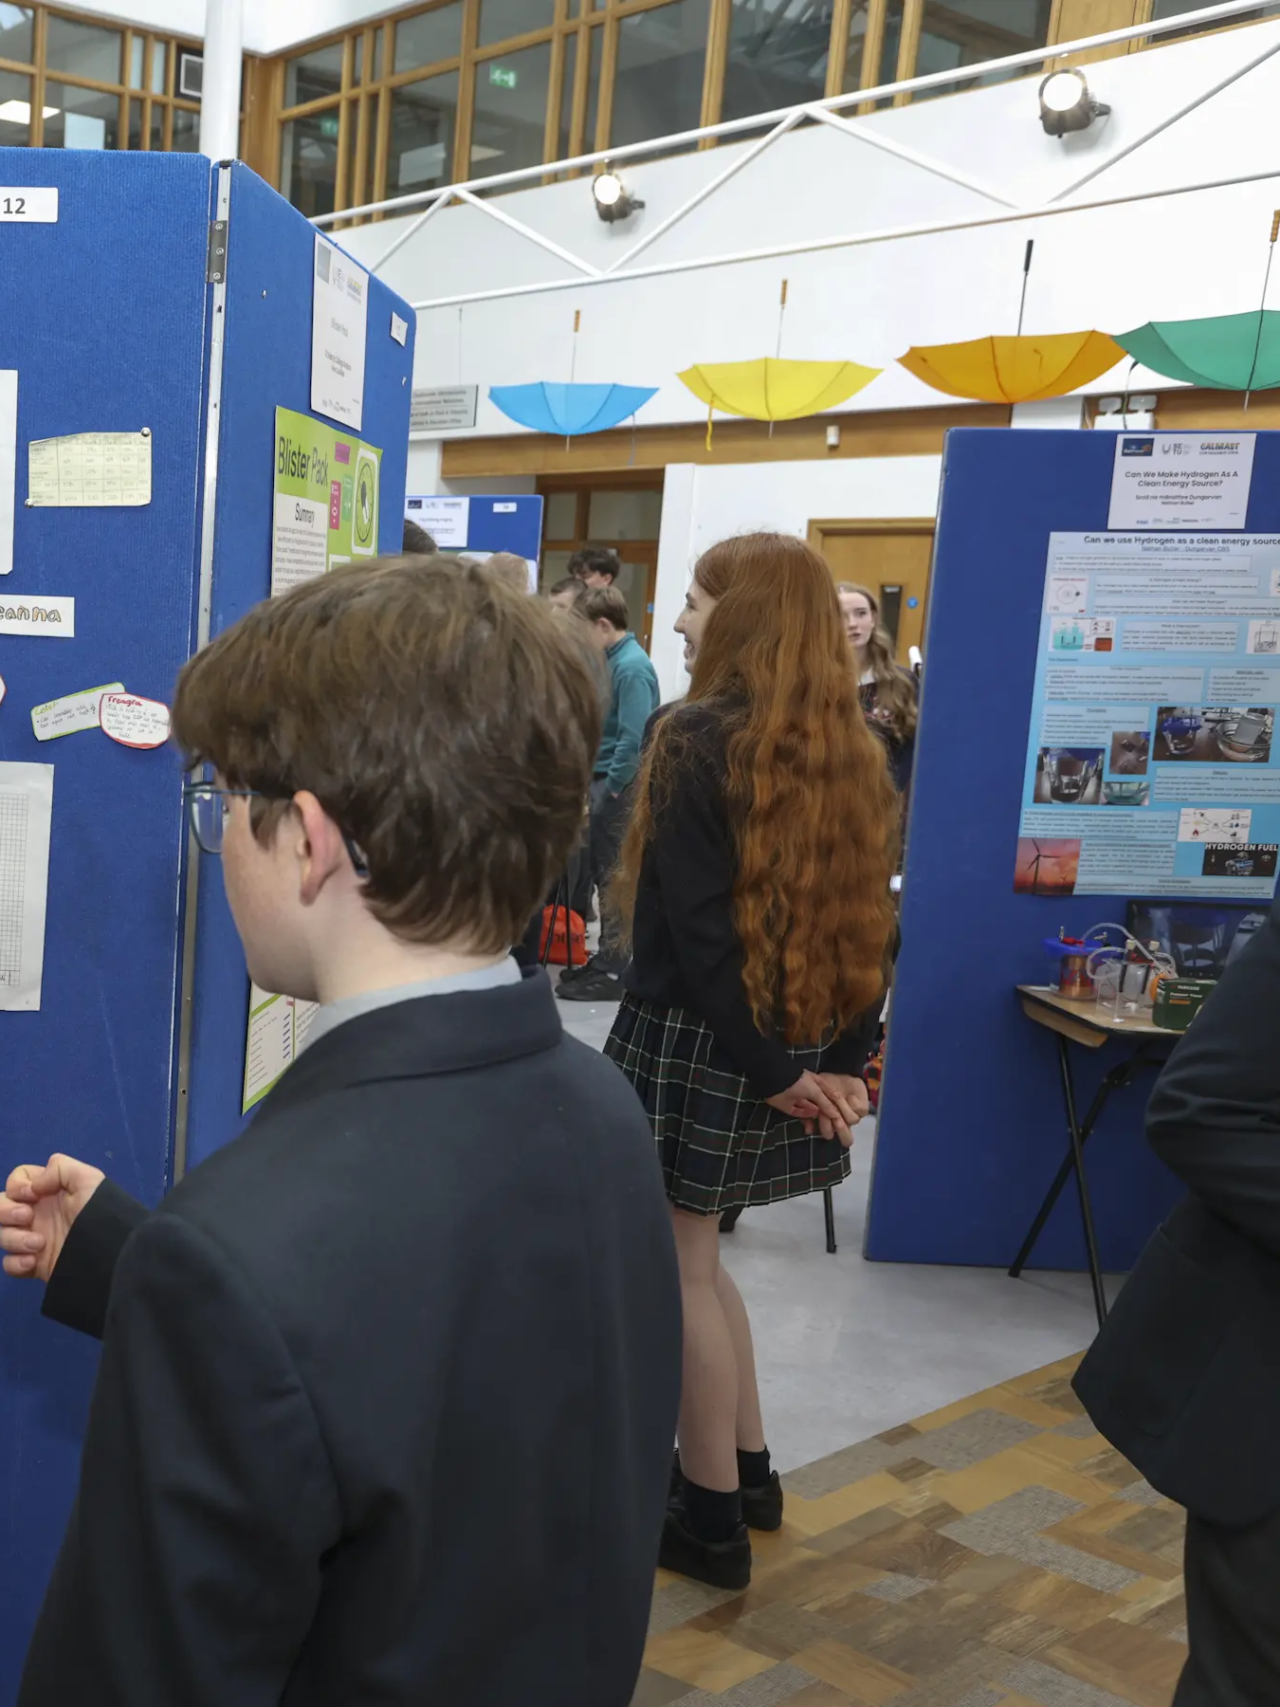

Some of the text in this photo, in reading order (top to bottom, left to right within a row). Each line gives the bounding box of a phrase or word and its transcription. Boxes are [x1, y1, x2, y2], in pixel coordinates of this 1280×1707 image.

[3, 197, 26, 214] 12
[278, 435, 329, 487] Blister Pack
[1180, 470, 1219, 480] Hydrogen
[1162, 480, 1190, 488] Energy
[1191, 479, 1223, 487] Source?
[1084, 536, 1102, 544] Can
[1134, 536, 1175, 546] Hydrogen
[1197, 536, 1220, 544] clean
[1221, 538, 1250, 546] energy
[1205, 843, 1256, 851] HYDROGEN
